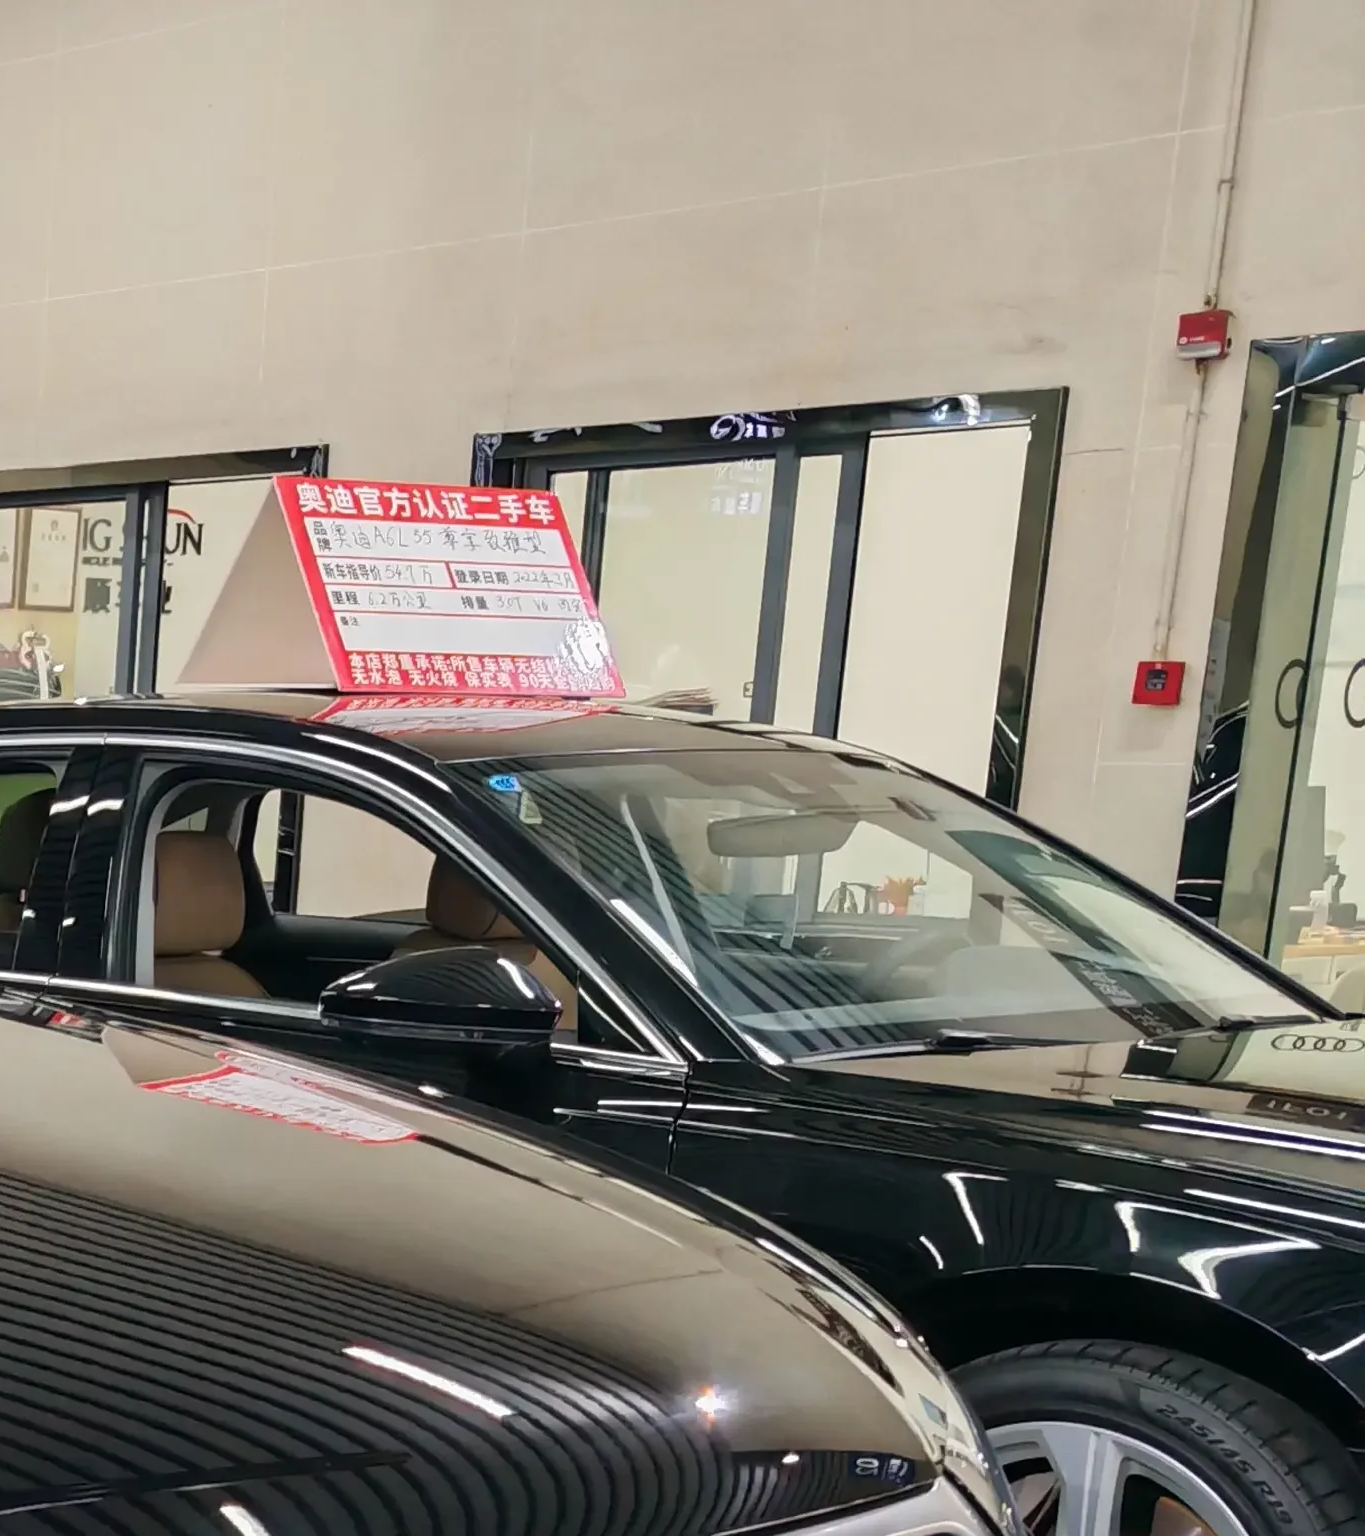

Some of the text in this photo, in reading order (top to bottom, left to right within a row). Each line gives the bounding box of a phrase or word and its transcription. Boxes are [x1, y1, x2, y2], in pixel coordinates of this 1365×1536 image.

[296, 483, 555, 526] 奥迪官方认证二手车
